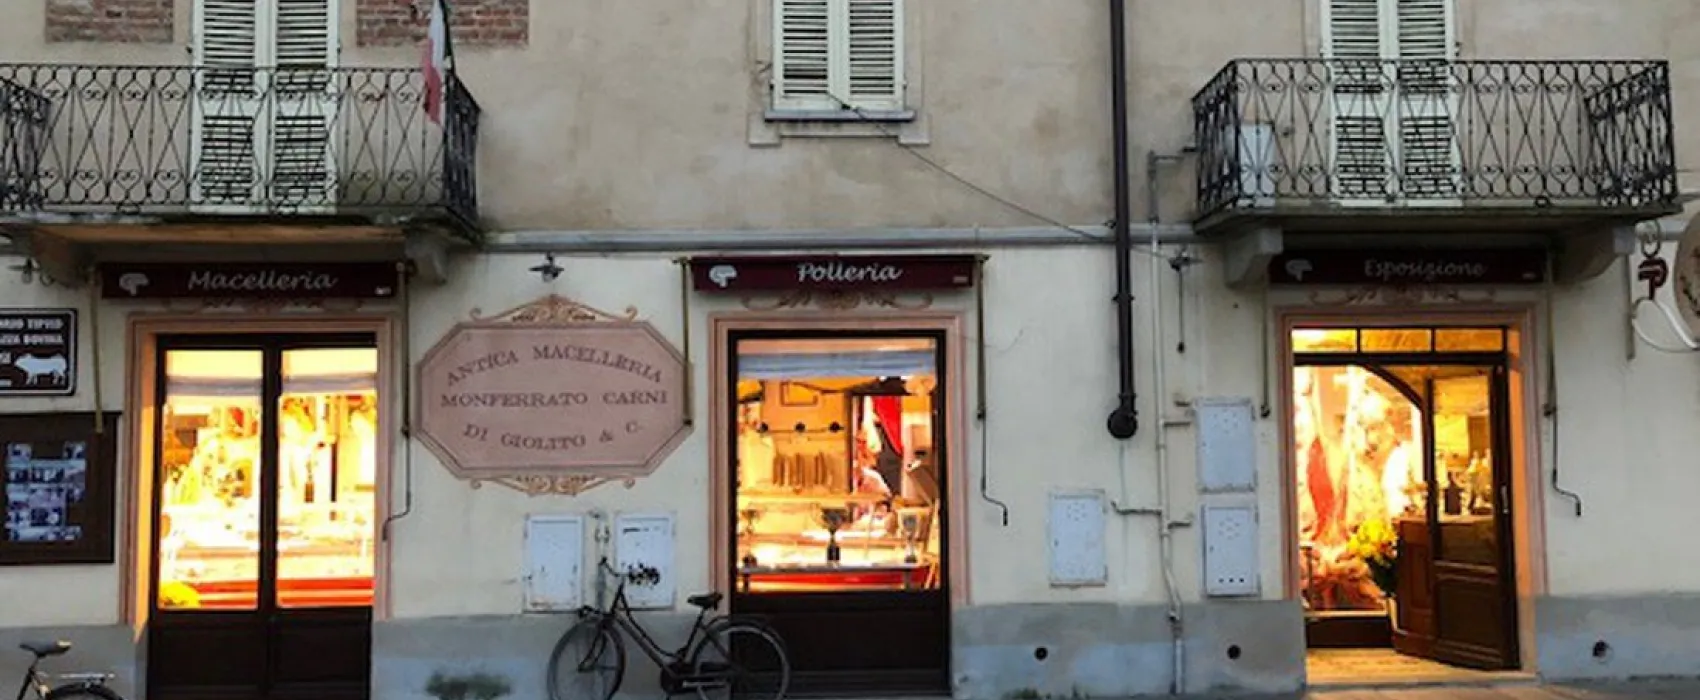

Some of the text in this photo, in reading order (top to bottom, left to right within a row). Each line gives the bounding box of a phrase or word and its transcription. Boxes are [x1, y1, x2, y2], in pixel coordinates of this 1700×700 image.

[187, 270, 338, 291] Macelleria
[797, 262, 902, 282] Polleria
[1364, 258, 1487, 282] Esposizione
[447, 345, 662, 387] ANTICA MACELLERIA
[440, 390, 668, 409] MONFERRATO CARNI
[463, 423, 488, 443] DI
[500, 432, 587, 451] GIOLITO
[599, 430, 614, 443] &
